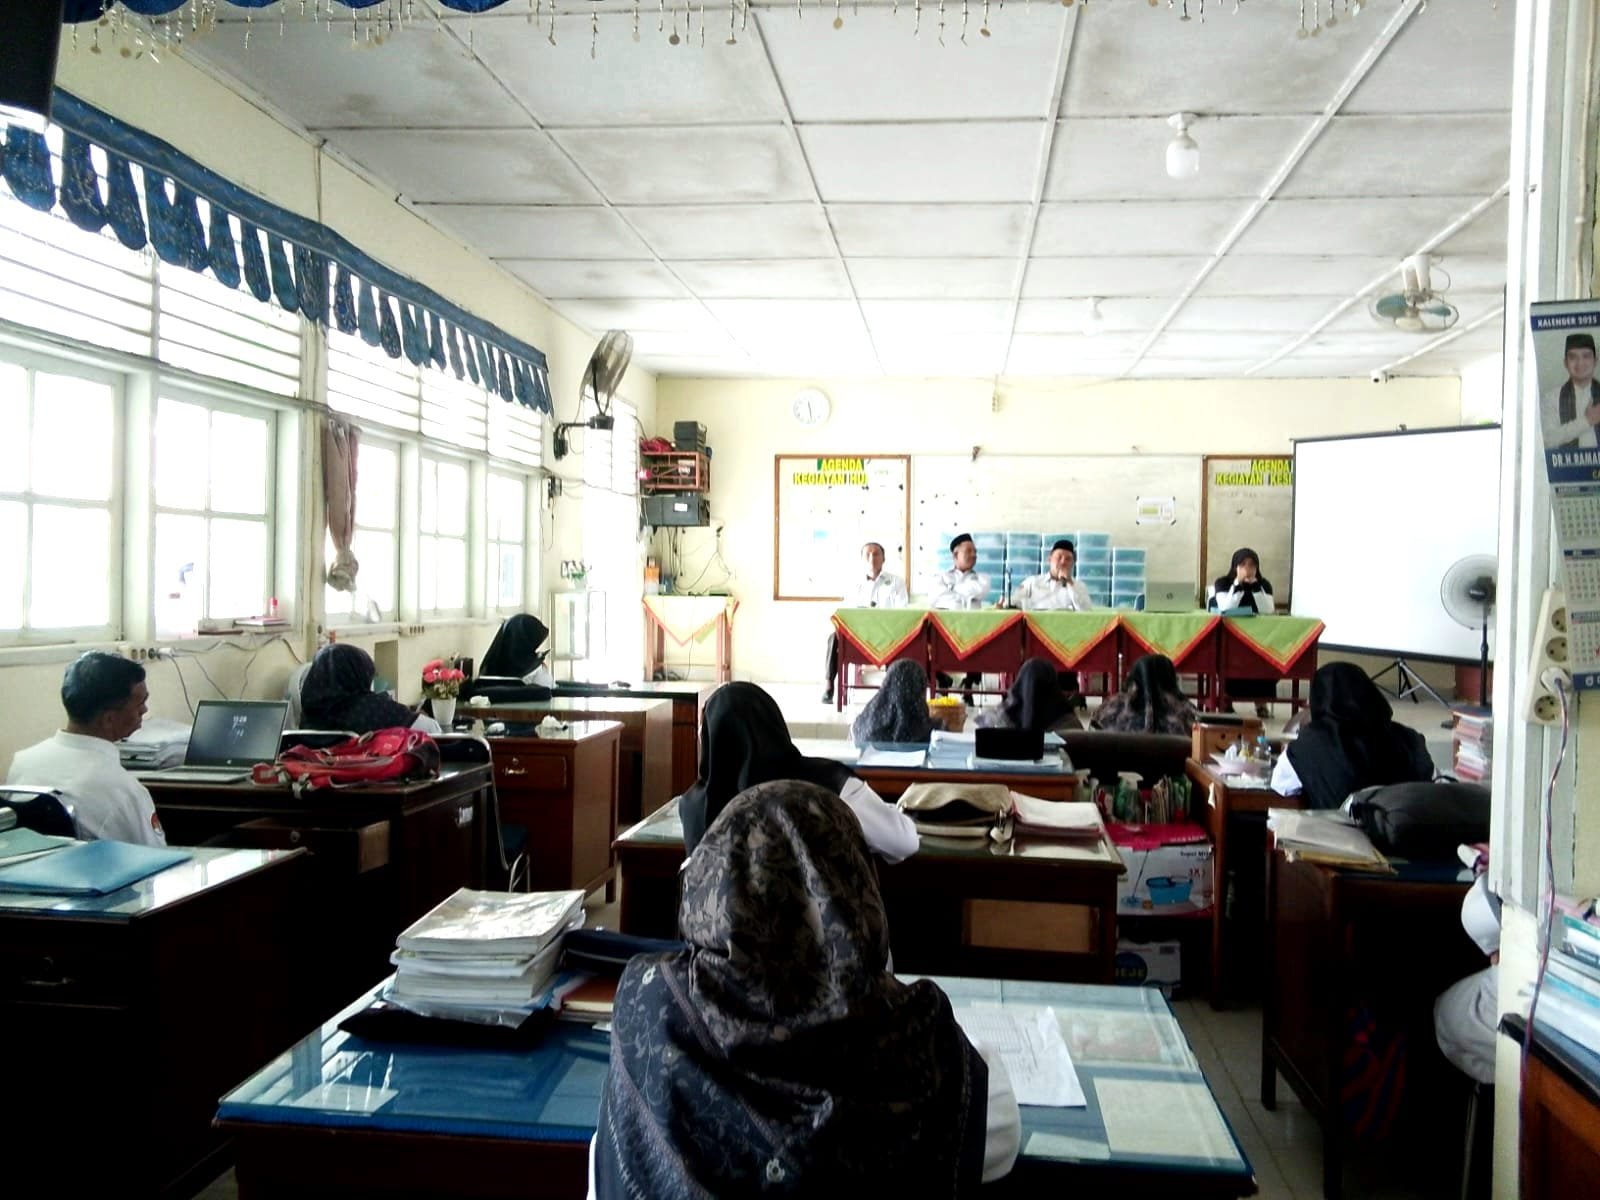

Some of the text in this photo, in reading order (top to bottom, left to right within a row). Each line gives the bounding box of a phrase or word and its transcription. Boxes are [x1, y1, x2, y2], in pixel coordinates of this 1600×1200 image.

[821, 458, 864, 471] AGENDA
[1252, 459, 1290, 472] AGENDA
[794, 472, 845, 486] KEGIATAN
[1216, 472, 1264, 486] KEGIATAN
